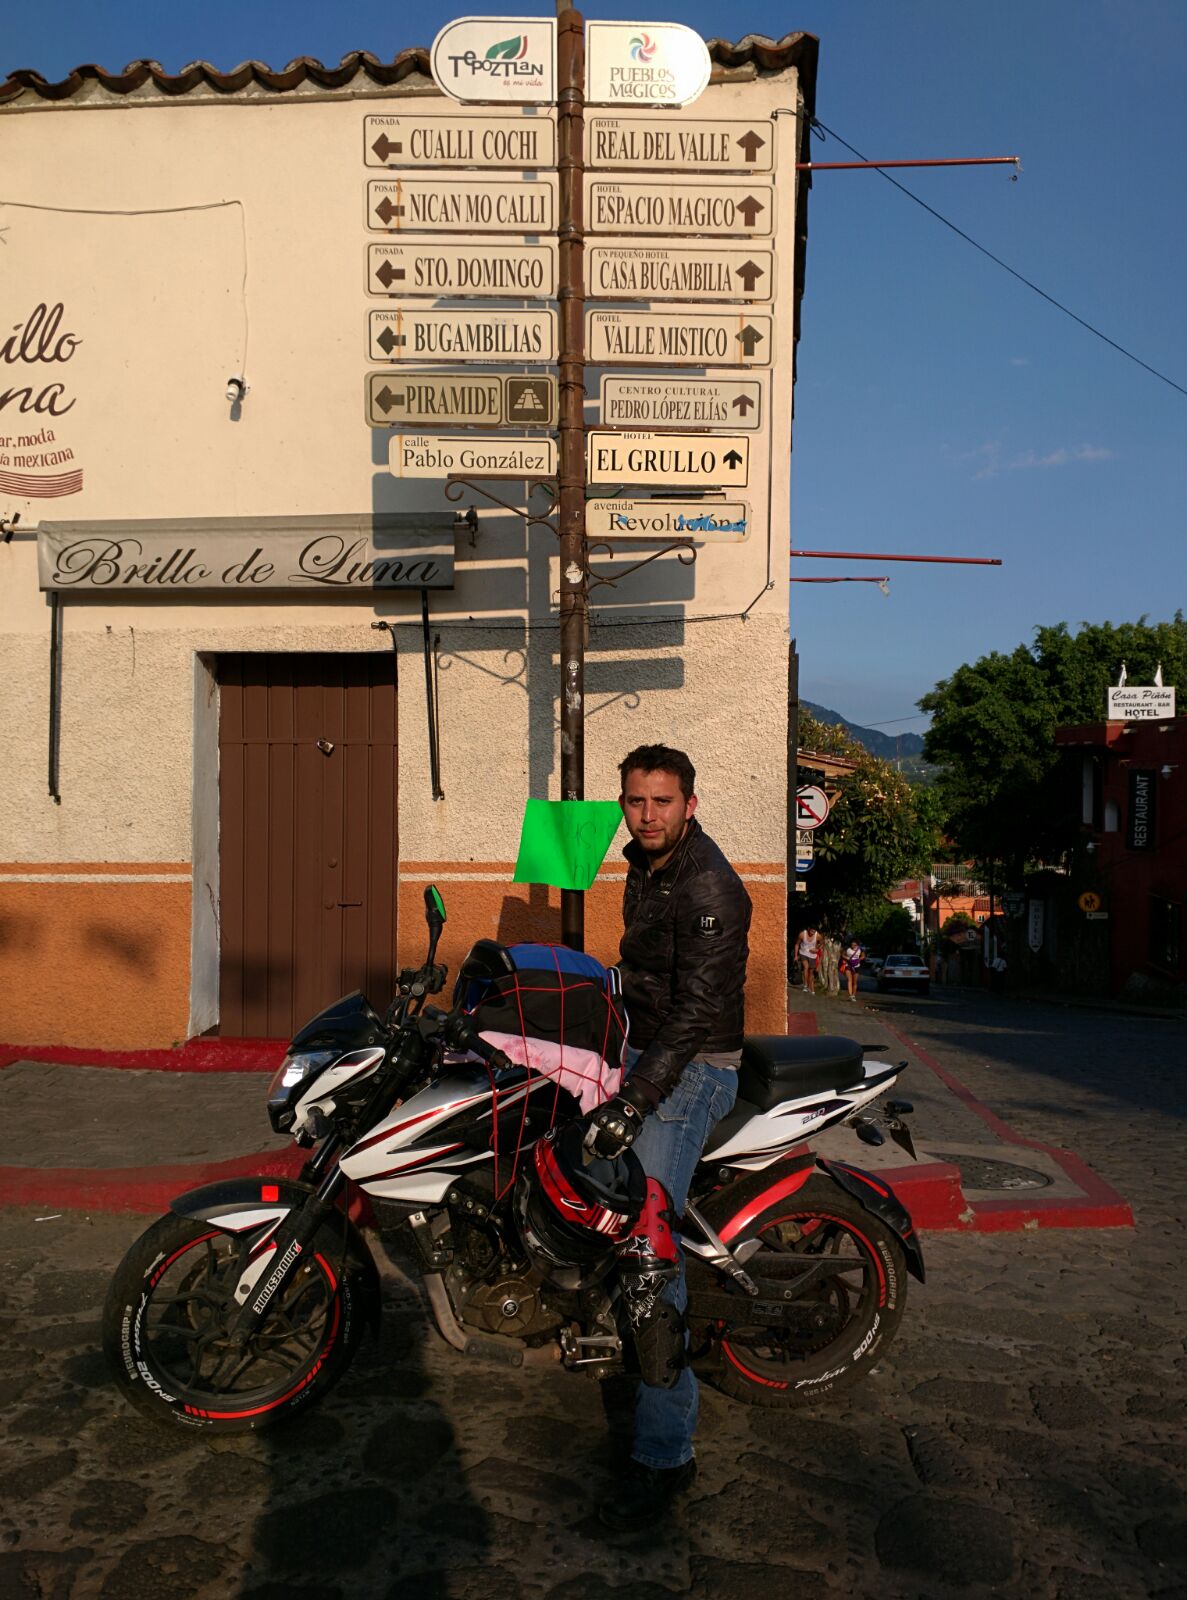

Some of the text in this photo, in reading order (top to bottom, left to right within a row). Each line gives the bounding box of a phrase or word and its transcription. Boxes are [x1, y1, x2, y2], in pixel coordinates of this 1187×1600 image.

[370, 118, 400, 126] POSADA
[411, 129, 537, 160] CUALLI COCHI
[597, 131, 730, 162] REAL DEL VALLE
[597, 185, 622, 193] HOTEL
[411, 194, 545, 223] NICAN MO CALLI
[597, 196, 735, 227] ESPACIO MAGICO
[645, 251, 670, 259] HOTEL
[415, 258, 543, 288] STO. DOMINGO
[600, 258, 732, 291] CASA BUGAMBILIA
[414, 322, 542, 354] BUGAMBILIAS
[604, 326, 727, 356] VALLE MISTICO
[406, 385, 498, 416] PIRAMIDE
[663, 387, 720, 396] CULTURAL
[611, 395, 727, 420] PEDRO LÓPEZ ELÍAS
[405, 437, 429, 447] calle
[14, 448, 74, 469] mexicana
[404, 449, 544, 469] Pablo González
[598, 450, 715, 473] EL GRULLO
[594, 501, 633, 511] avenida
[53, 536, 439, 585] Brillo de Luna
[1112, 690, 1137, 700] Casa
[1134, 774, 1149, 847] RESTAURANT
[253, 1238, 303, 1315] BRIDGESTONE
[121, 1314, 139, 1375] EUROGRIP
